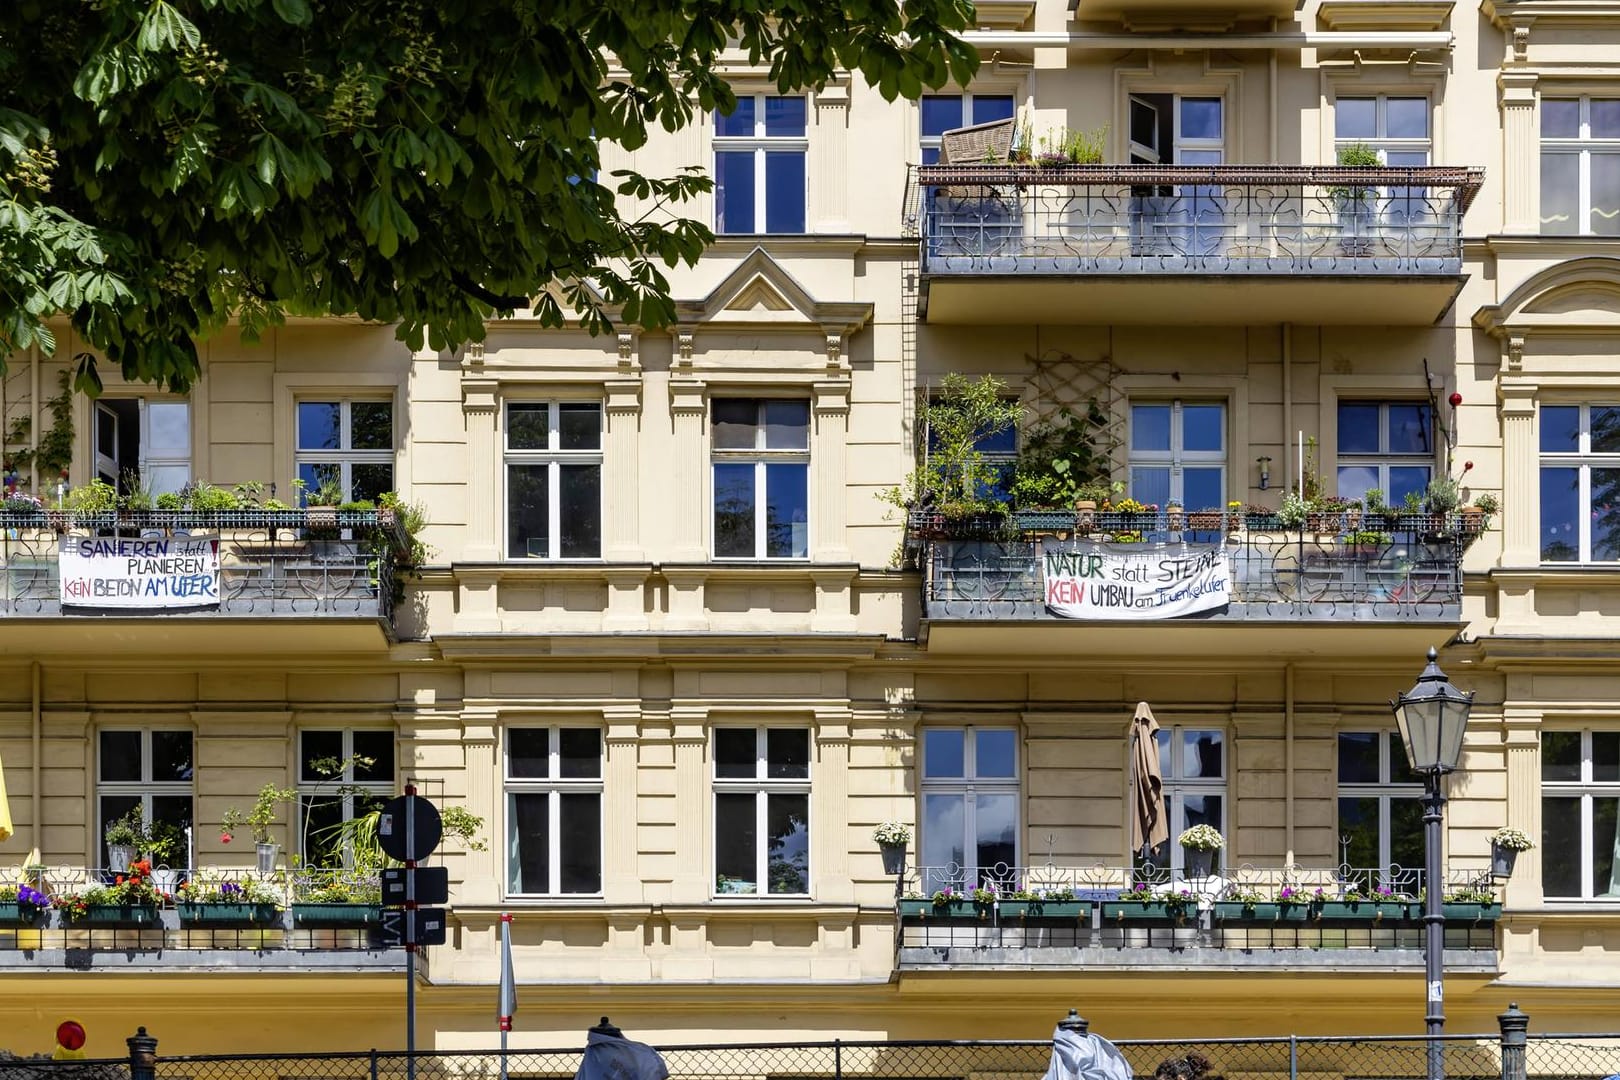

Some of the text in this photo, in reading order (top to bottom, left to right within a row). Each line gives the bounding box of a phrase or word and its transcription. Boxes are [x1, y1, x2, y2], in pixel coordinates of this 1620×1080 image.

[80, 539, 169, 559] SANIEREN
[176, 540, 207, 557] statt
[127, 558, 205, 576] PLANIEREN
[1046, 549, 1105, 579] NATUR
[1112, 562, 1149, 583] statt
[94, 578, 142, 597] BETON
[145, 576, 168, 597] AM
[1091, 584, 1134, 608] UMBAU
[1135, 597, 1154, 608] am
